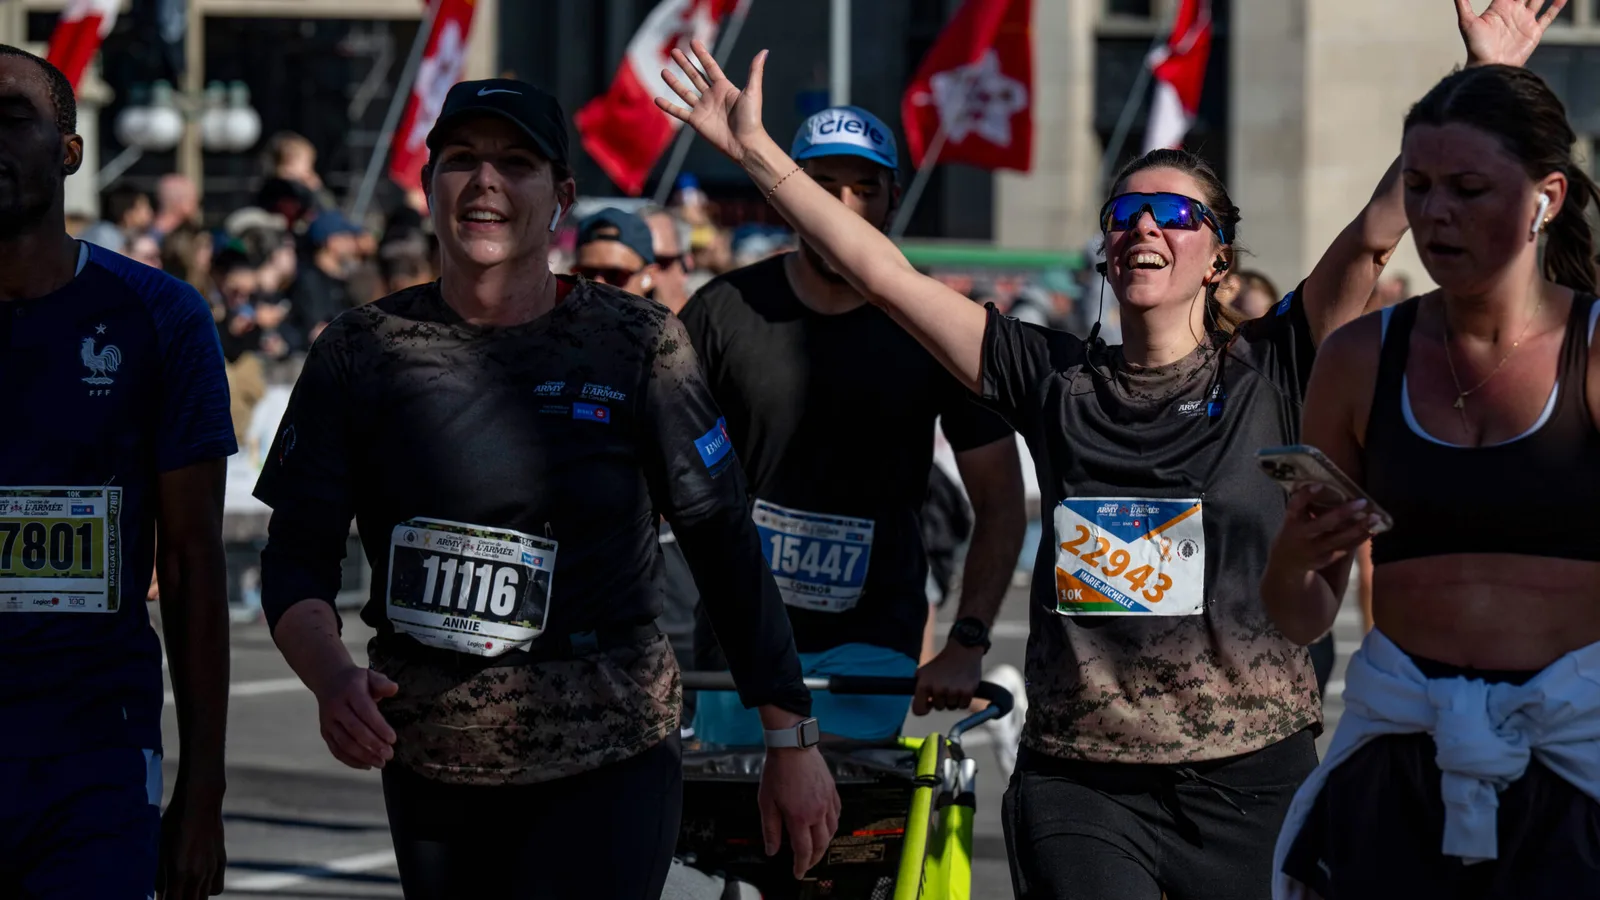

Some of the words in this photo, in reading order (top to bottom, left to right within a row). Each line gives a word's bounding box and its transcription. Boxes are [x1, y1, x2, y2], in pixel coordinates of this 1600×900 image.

[819, 115, 885, 146] ciele
[88, 389, 111, 397] FFF
[533, 384, 565, 393] ARMY
[704, 434, 725, 456] BMO
[67, 490, 81, 498] 10K
[24, 503, 63, 512] L'ARMÉE
[108, 491, 119, 515] 27801
[108, 524, 116, 542] TAG
[0, 521, 93, 570] 7801
[436, 538, 461, 548] ARMY
[476, 544, 514, 556] L'ARMÉE
[769, 532, 863, 582] 15447
[1060, 524, 1173, 603] 22943
[108, 544, 116, 587] BAGGAGE
[421, 554, 520, 617] 11116
[790, 581, 831, 594] CONNOR
[1078, 570, 1135, 609] MARIE-MICHELLE
[33, 598, 51, 606] Legion
[1060, 588, 1083, 601] 10K
[442, 616, 481, 632] ANNIE
[467, 639, 485, 649] Legion
